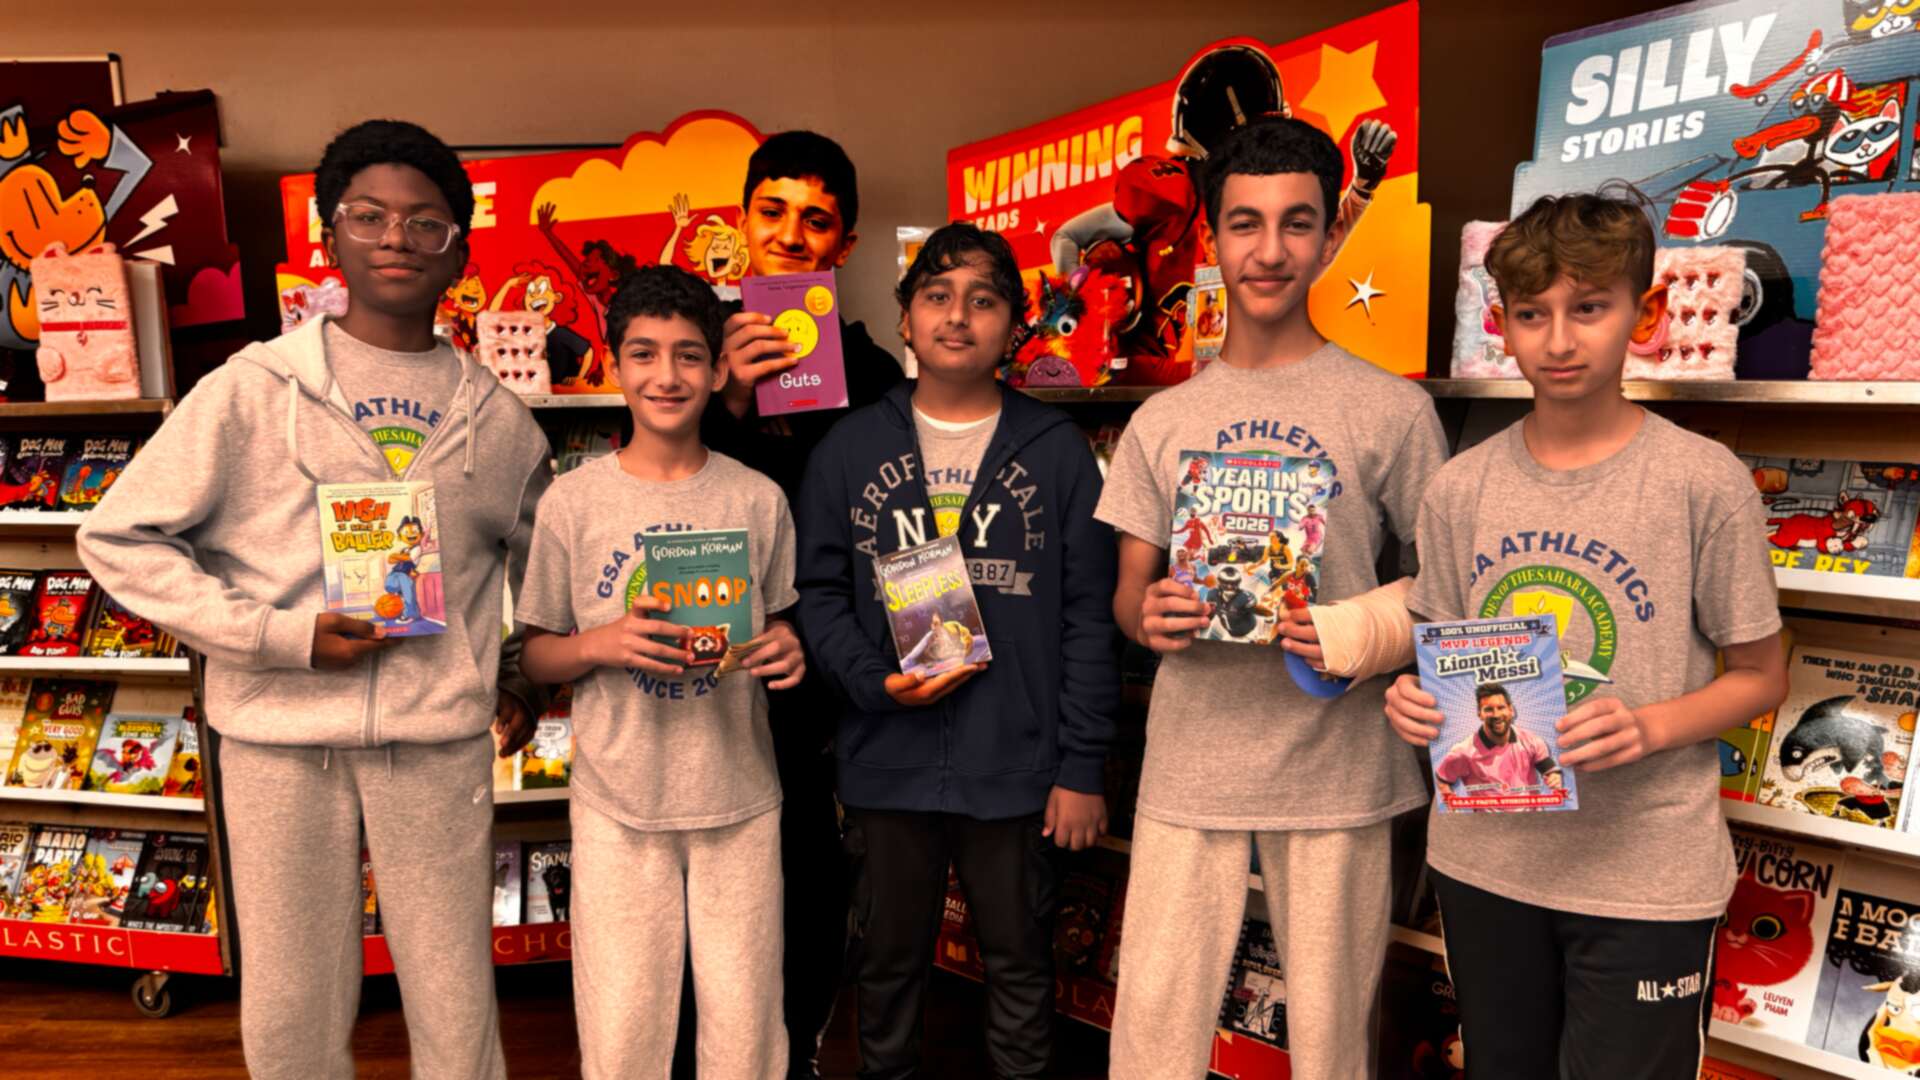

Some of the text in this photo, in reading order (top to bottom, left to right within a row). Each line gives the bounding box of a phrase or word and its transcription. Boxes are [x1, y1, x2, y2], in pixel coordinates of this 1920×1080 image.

[1565, 13, 1777, 126] SILLY
[1561, 111, 1705, 162] STORIES
[963, 116, 1143, 214] WINNING
[972, 209, 1020, 232] EADS
[779, 372, 822, 389] Guts
[1211, 466, 1298, 491] YEAR IN
[331, 498, 391, 522] WISH
[1195, 486, 1310, 524] SPORTS
[1225, 516, 1270, 533] 2026
[331, 531, 394, 552] BALLER
[652, 541, 744, 561] GORDON KORMAN
[47, 577, 70, 591] DOG
[597, 550, 630, 598] GSA
[1500, 530, 1656, 623] ATHLETICS
[652, 575, 748, 608] SNOOP
[884, 570, 964, 613] SLEEPLESS
[1466, 622, 1528, 634] UNOFFICIAL
[1440, 635, 1531, 649] MVP LEGENDS
[1438, 649, 1500, 673] Lionel
[1478, 659, 1537, 682] Messi
[1801, 655, 1915, 679] THERE WAS AN OLD
[1825, 669, 1855, 681] WHO
[1856, 684, 1866, 694] A
[37, 832, 87, 850] MARIO
[34, 847, 83, 866] PARTY
[1758, 853, 1834, 899] CORN
[1636, 972, 1702, 1001] ALL STAR
[1763, 991, 1794, 1007] LEUYEN
[1764, 1002, 1789, 1017] PHAM
